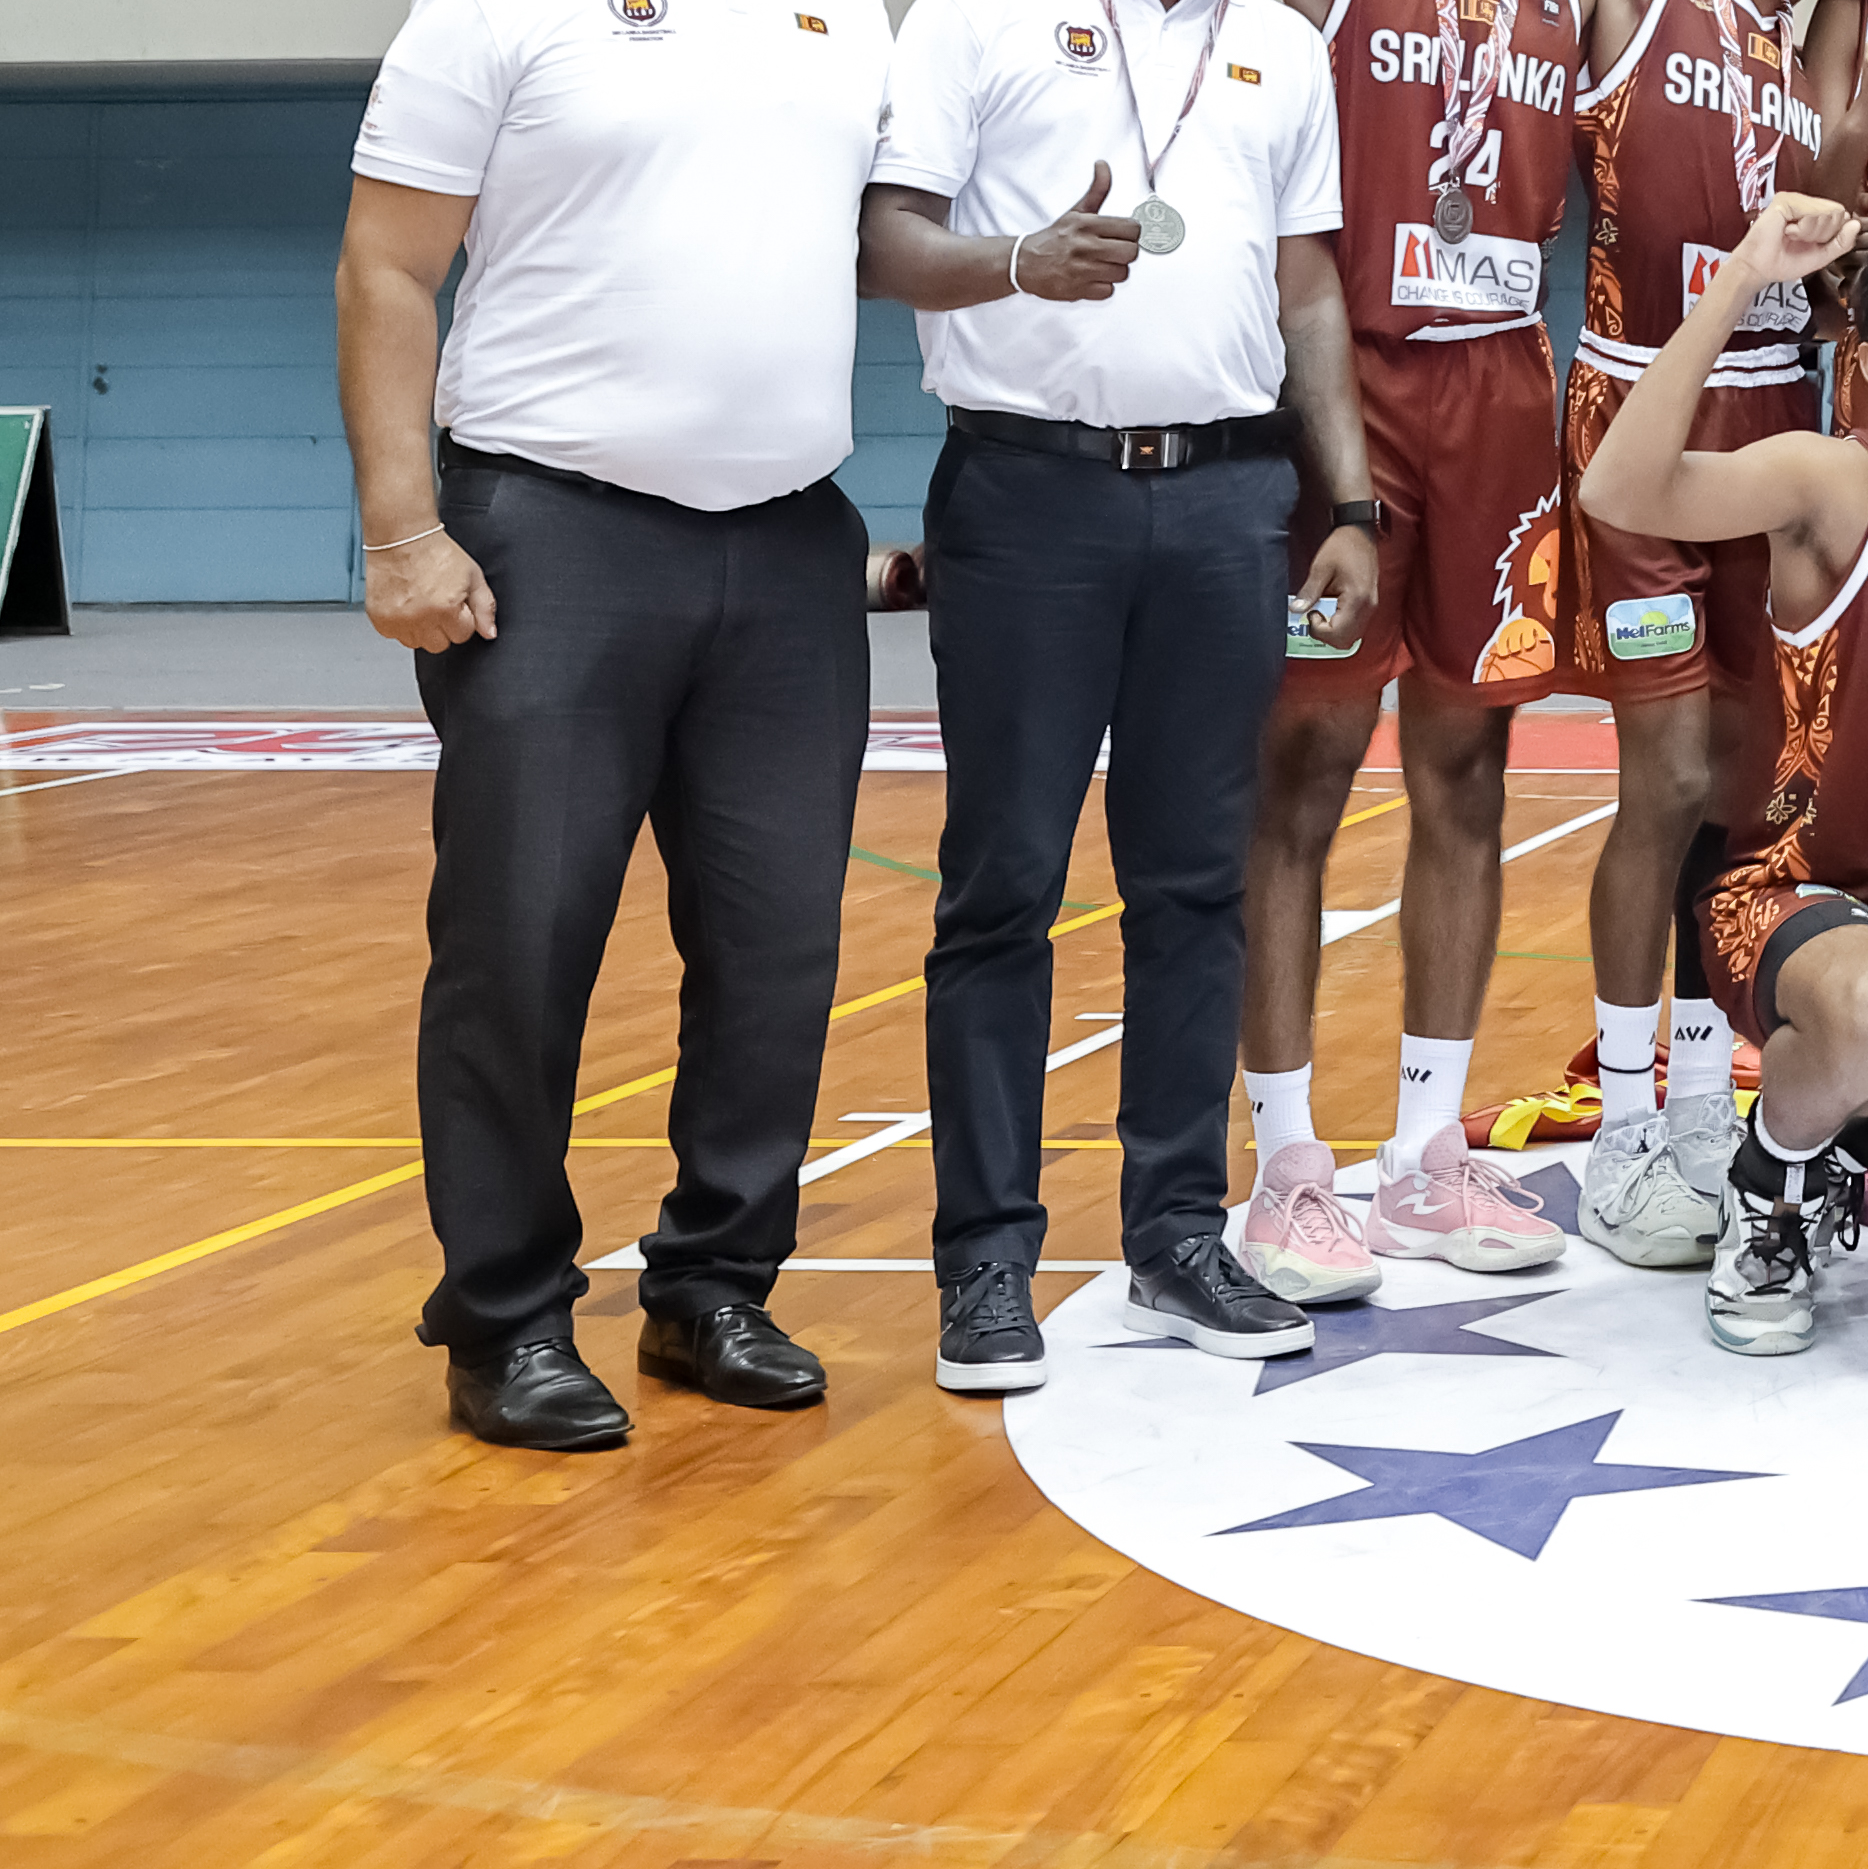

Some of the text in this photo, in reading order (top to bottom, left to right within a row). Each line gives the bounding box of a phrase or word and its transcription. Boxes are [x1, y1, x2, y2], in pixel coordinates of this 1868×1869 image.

[1370, 28, 1441, 86] SRI
[1436, 248, 1535, 293] MAS
[1754, 281, 1810, 313] AS
